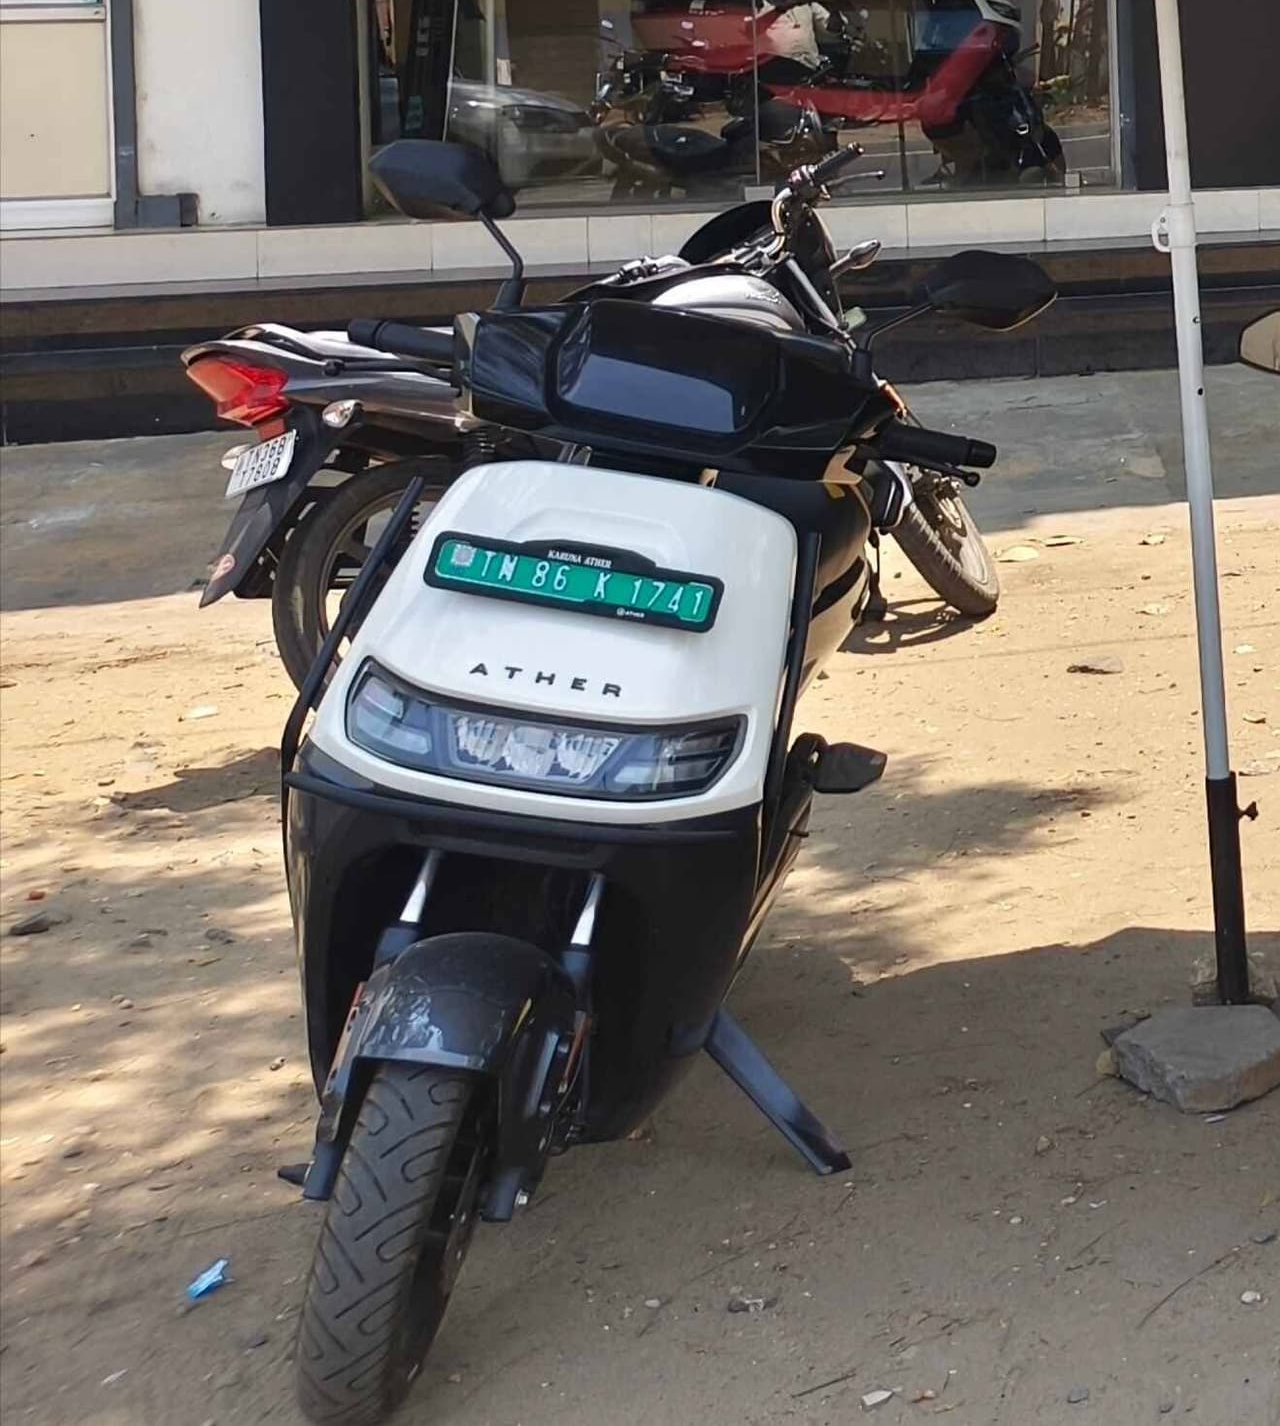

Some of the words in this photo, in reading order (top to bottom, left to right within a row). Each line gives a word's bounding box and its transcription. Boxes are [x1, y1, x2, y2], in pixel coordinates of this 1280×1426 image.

[481, 550, 519, 583] TN
[531, 560, 572, 592] 86
[631, 577, 705, 616] 1741
[469, 662, 624, 698] ATHER
